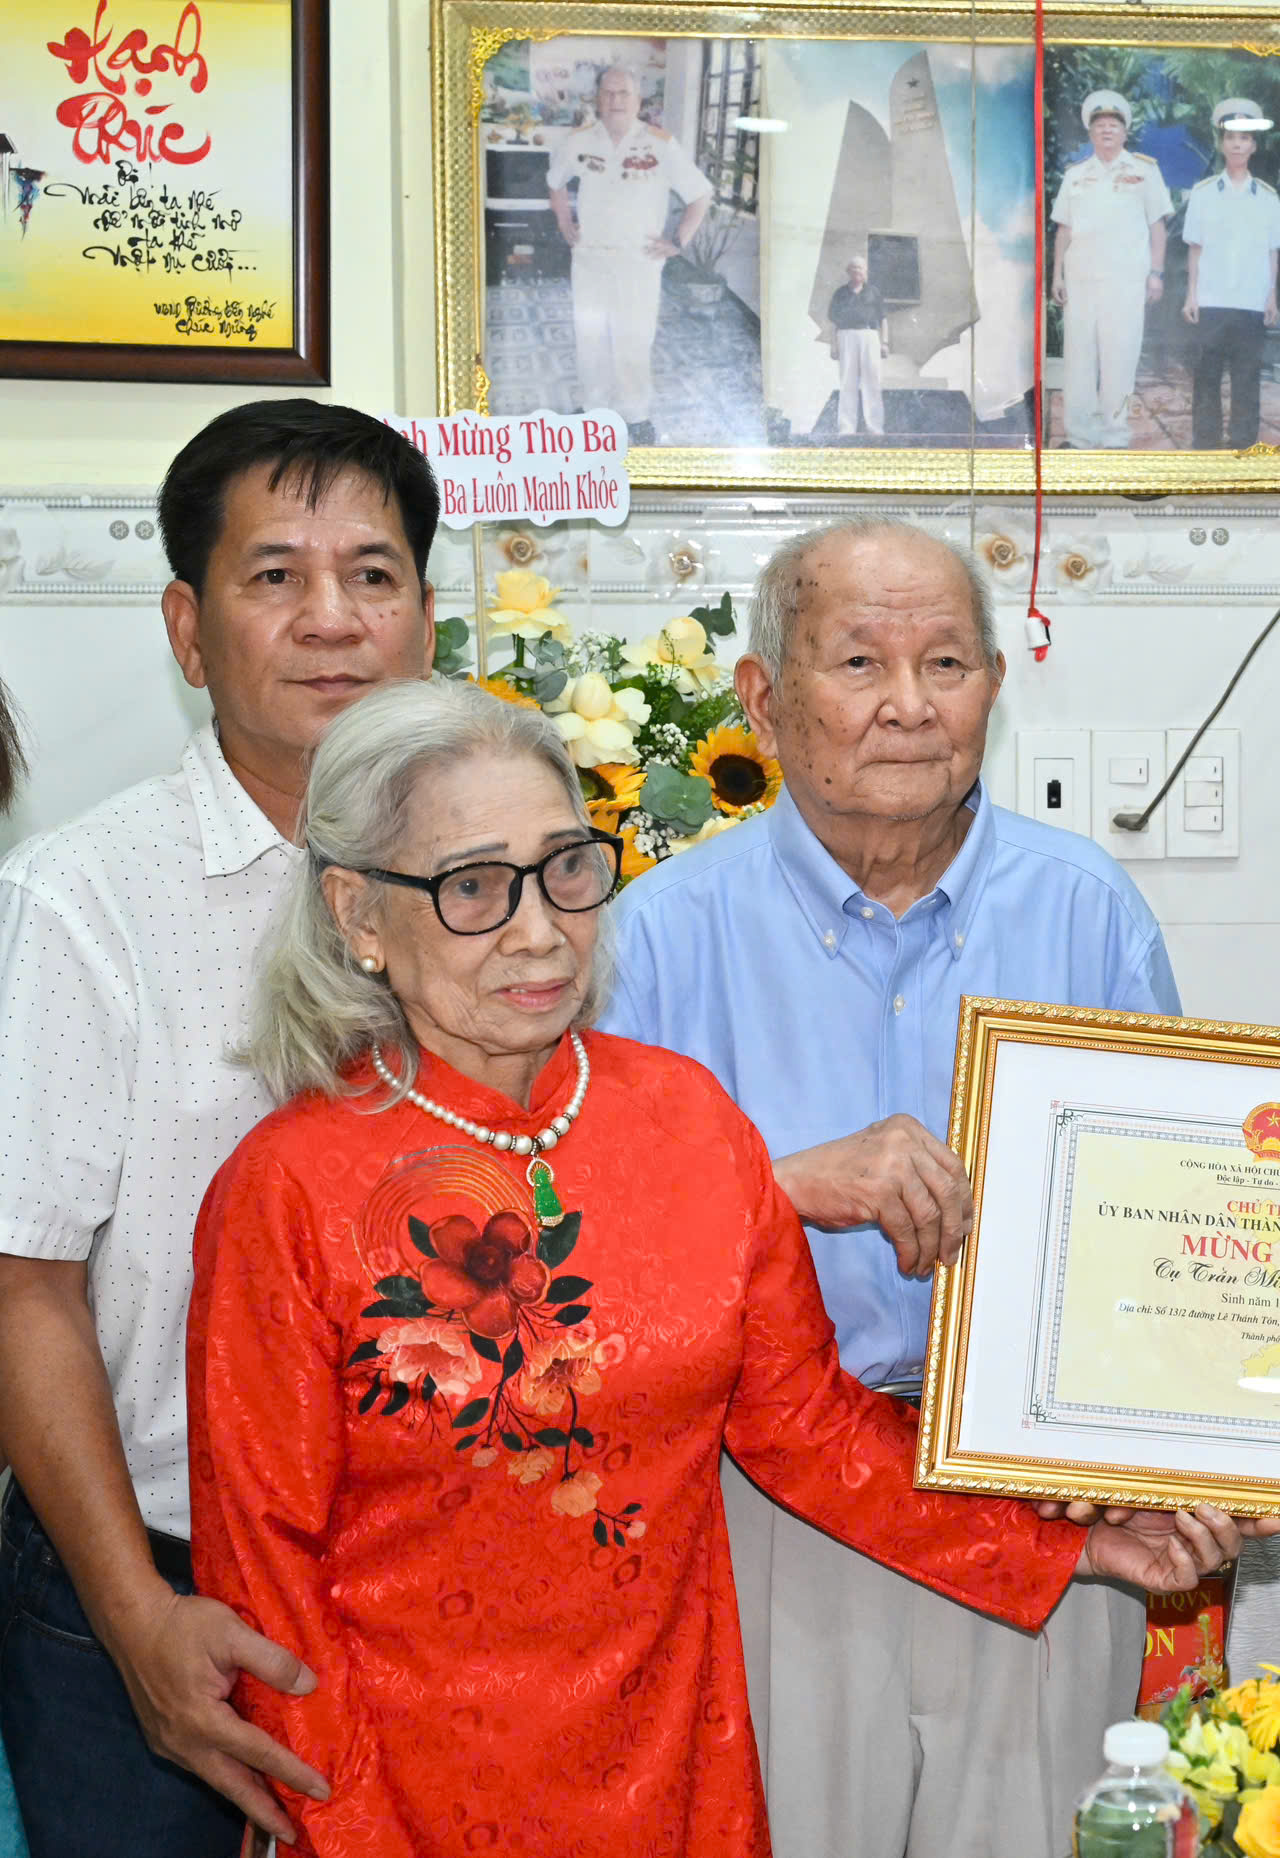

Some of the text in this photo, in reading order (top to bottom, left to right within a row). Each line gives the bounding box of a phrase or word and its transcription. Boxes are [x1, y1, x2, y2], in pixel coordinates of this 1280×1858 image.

[47, 0, 208, 96] Hạnh
[56, 91, 212, 165] Phúc
[438, 416, 512, 463] Mừng
[519, 418, 574, 463] Thọ
[581, 420, 617, 453] Ba
[443, 465, 619, 522] Ba Luôn Mạnh Khỏe
[1180, 1159, 1206, 1171] CỘNG
[1230, 1163, 1242, 1173] XÃ
[1244, 1165, 1261, 1176] HỘI
[1216, 1174, 1231, 1183] Độc
[1233, 1175, 1245, 1185] lập
[1264, 1178, 1274, 1186] do
[1098, 1201, 1119, 1217] ỦY
[1123, 1206, 1154, 1222] BAN
[1158, 1209, 1201, 1226] NHÂN
[1205, 1213, 1237, 1229] DÂN
[1226, 1198, 1264, 1215] CHỦ
[1180, 1231, 1273, 1263] MỪNG
[1153, 1257, 1182, 1283] Cụ
[1188, 1260, 1239, 1285] Trần
[1221, 1292, 1245, 1306] Sinh
[1248, 1295, 1271, 1307] năm
[1154, 1304, 1167, 1315] Số
[1169, 1307, 1187, 1317] 13/2
[1188, 1309, 1216, 1321] đường
[1217, 1311, 1228, 1321] Lê
[1231, 1312, 1258, 1324] Thánh
[1261, 1315, 1280, 1327] Tôn,
[1241, 1331, 1265, 1343] Thành
[1266, 1333, 1280, 1344] phố
